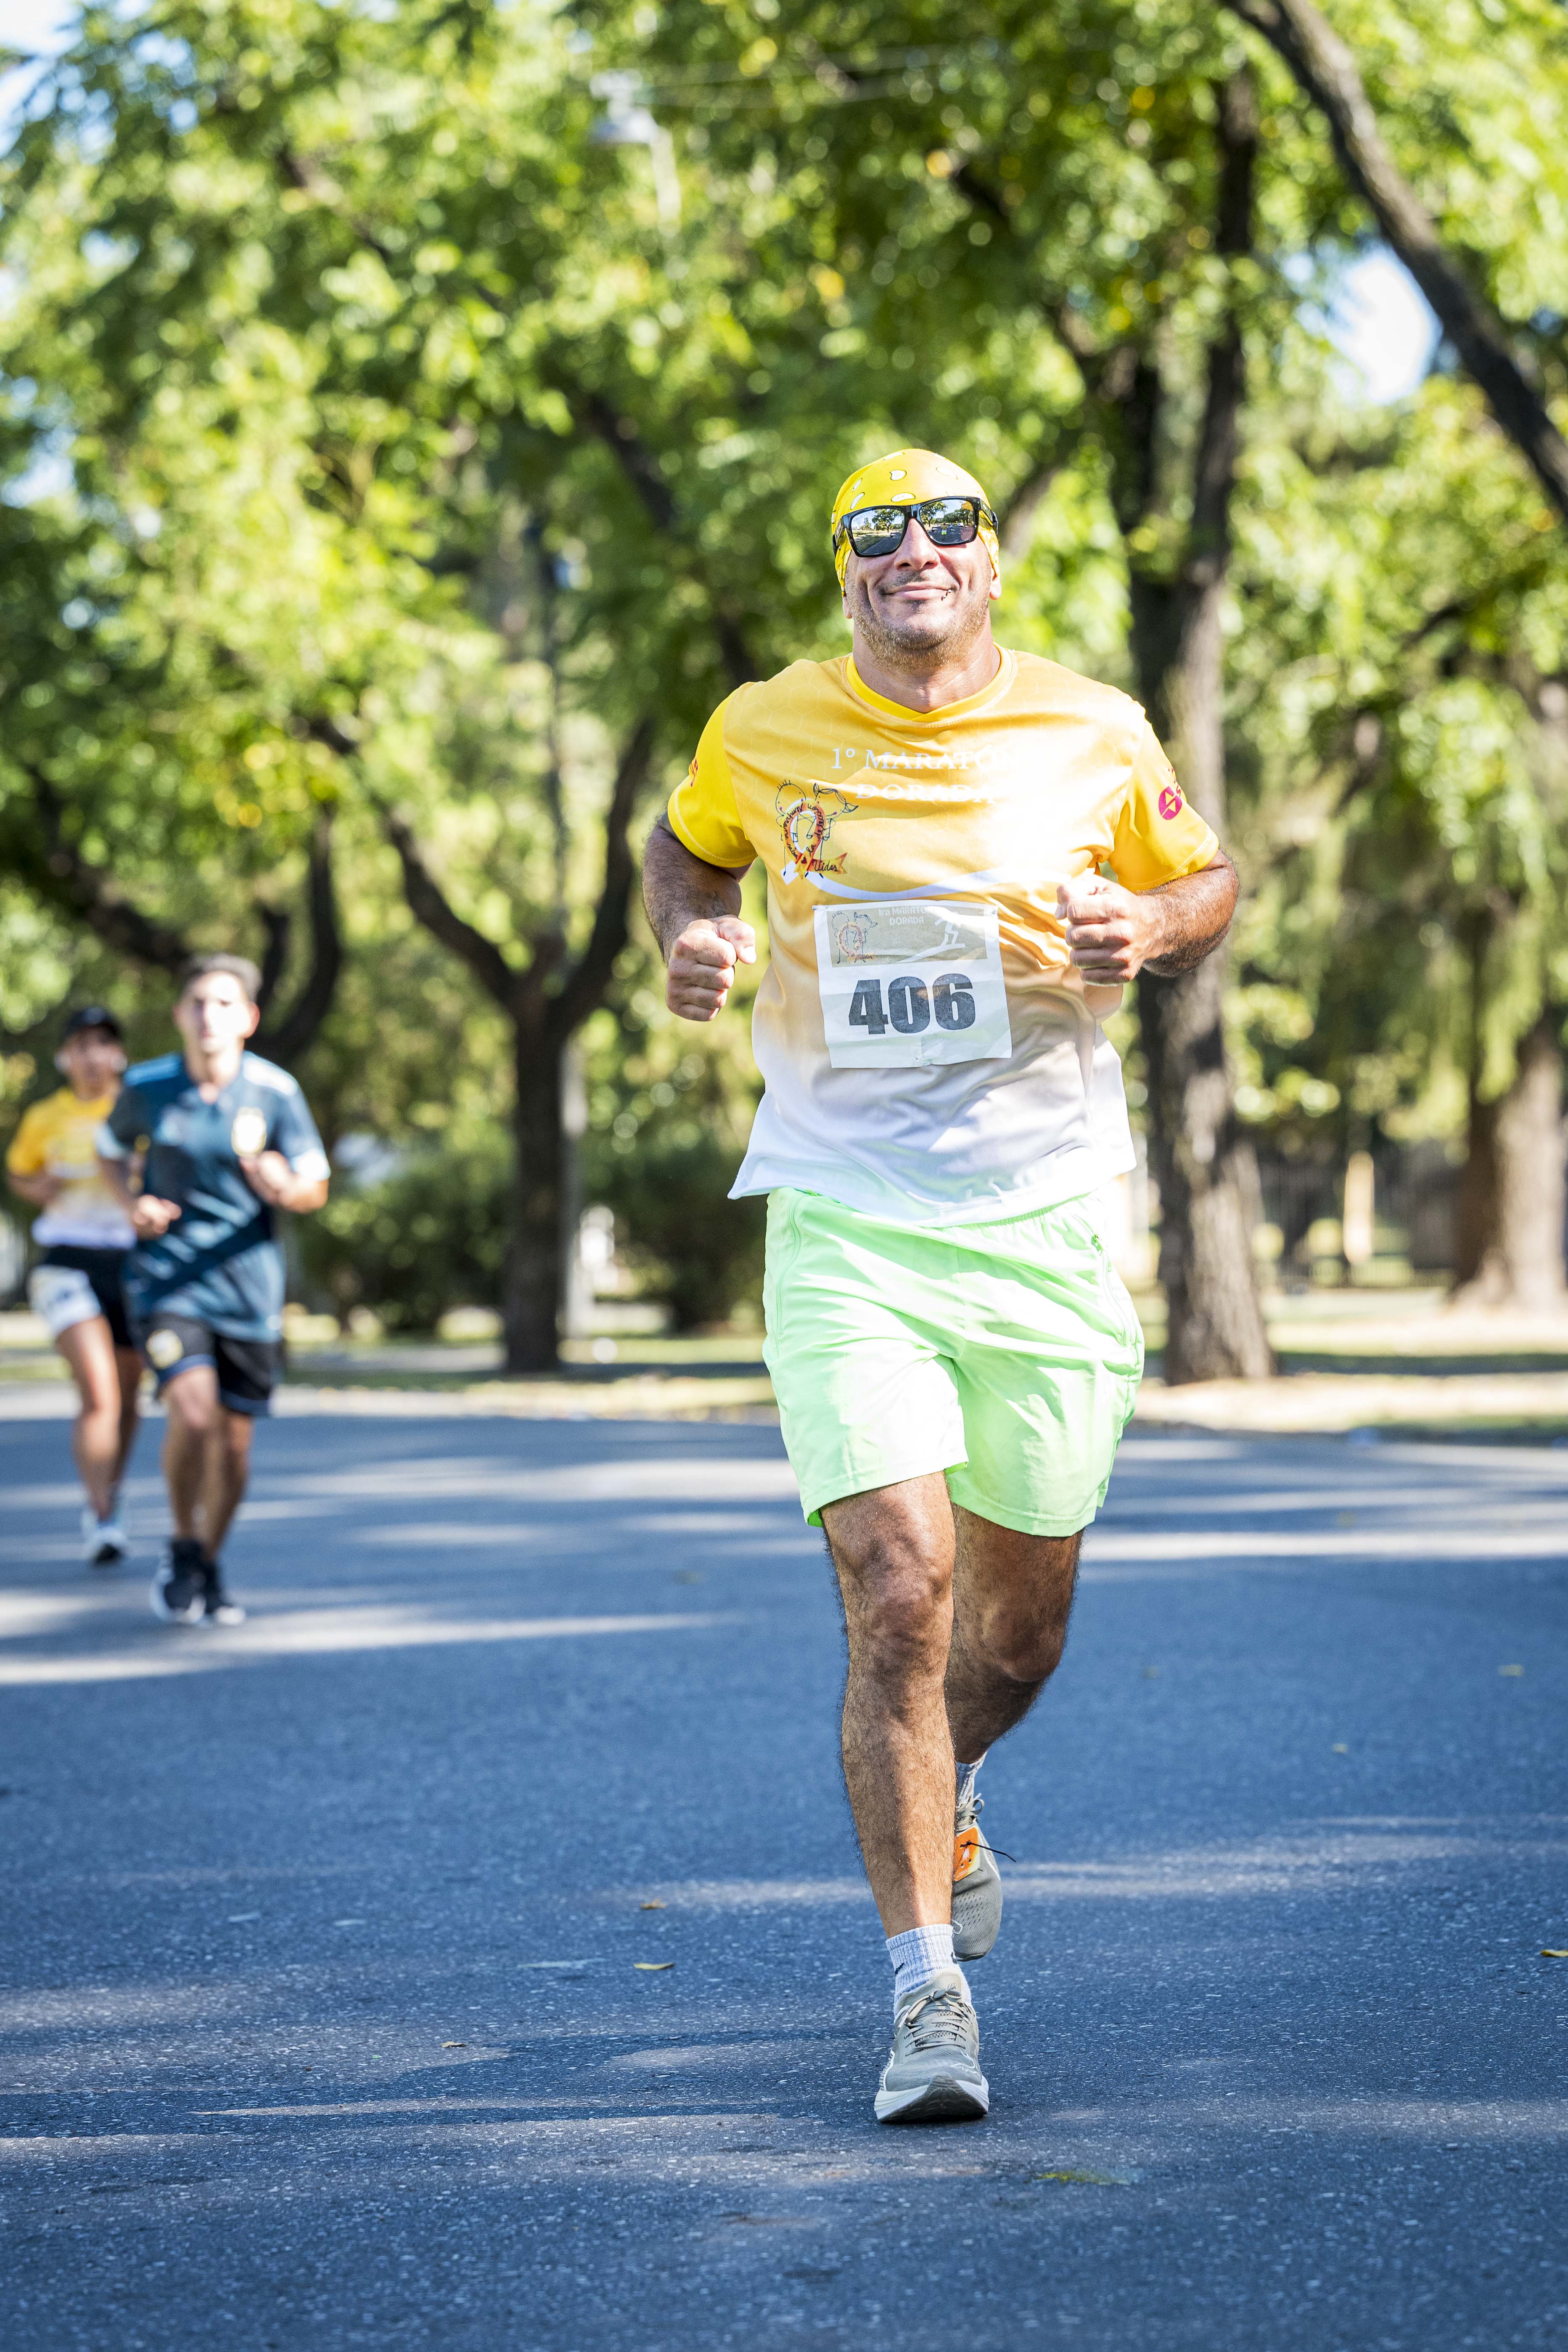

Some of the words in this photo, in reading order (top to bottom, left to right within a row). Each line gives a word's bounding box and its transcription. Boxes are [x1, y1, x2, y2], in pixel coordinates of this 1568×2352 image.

[855, 783, 996, 804] DORADA
[889, 916, 924, 925] DORADA
[849, 973, 976, 1035] 406
